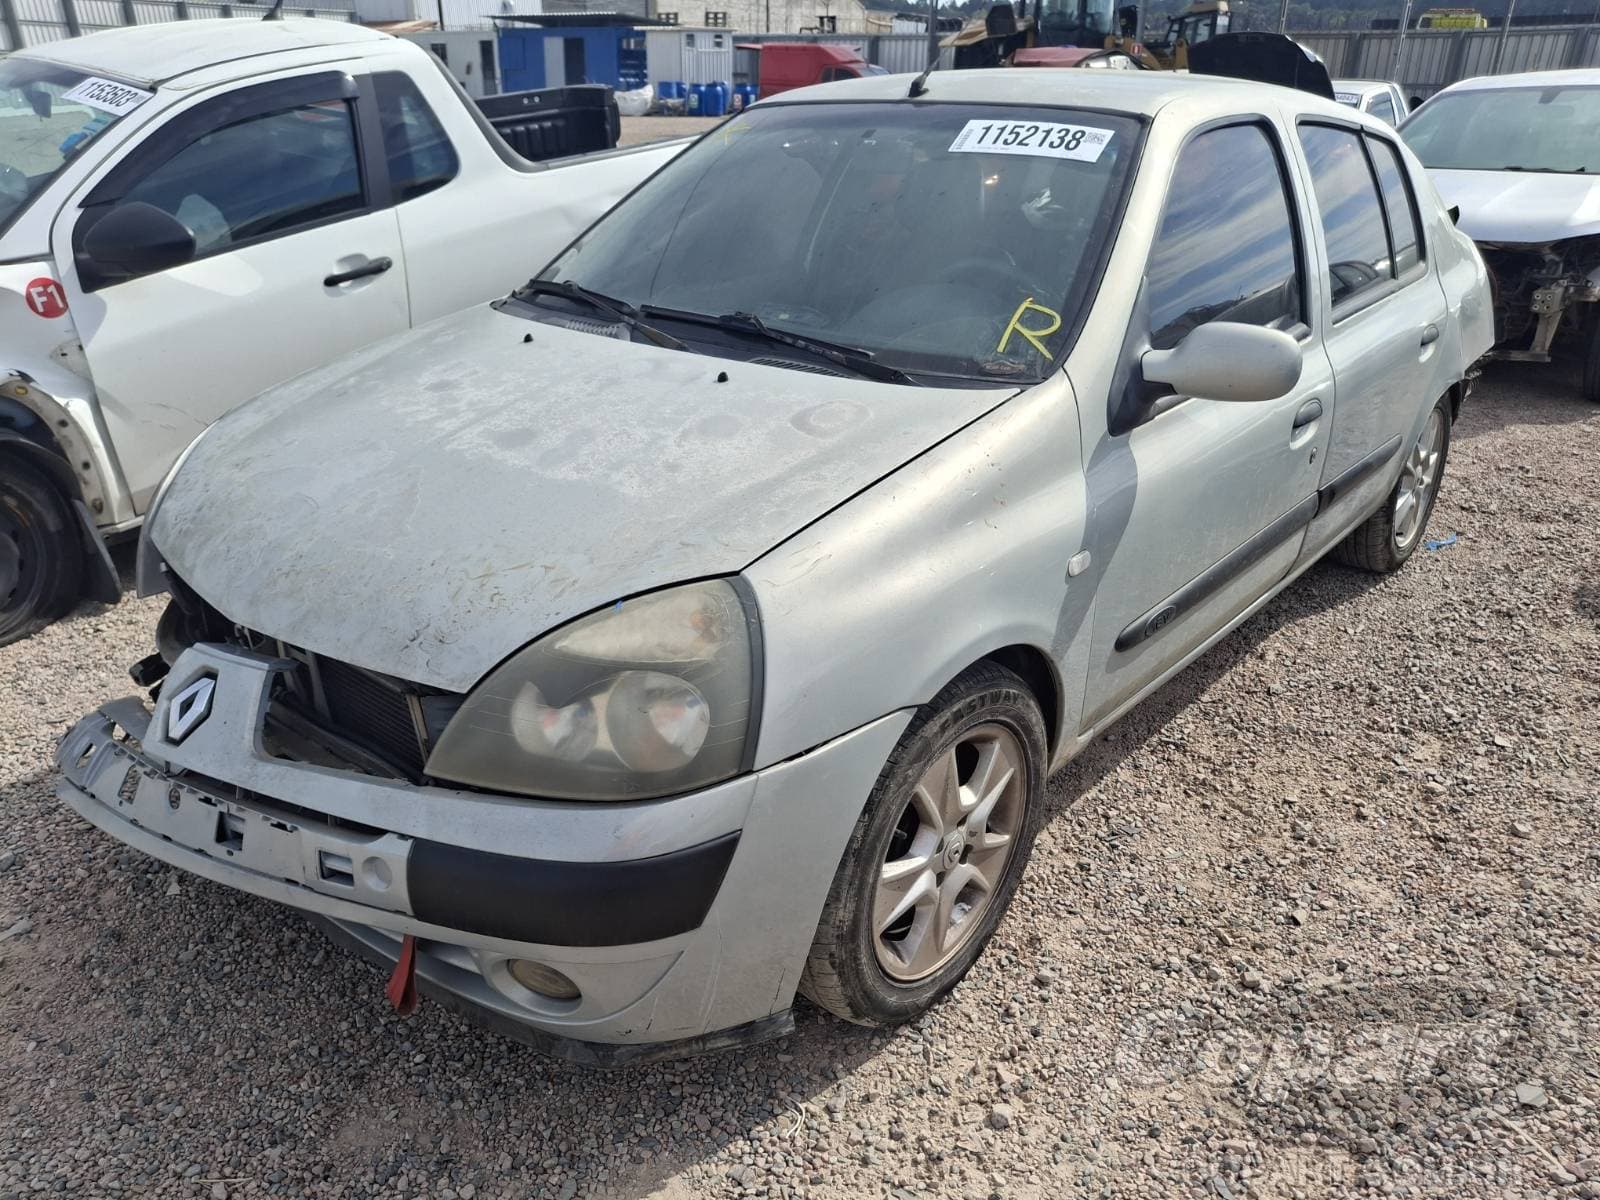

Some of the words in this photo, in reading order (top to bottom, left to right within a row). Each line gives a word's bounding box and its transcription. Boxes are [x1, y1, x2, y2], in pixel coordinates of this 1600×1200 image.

[79, 81, 139, 107] 1153503
[977, 123, 1087, 152] 1152138
[30, 284, 64, 312] F1
[996, 296, 1062, 361] R
